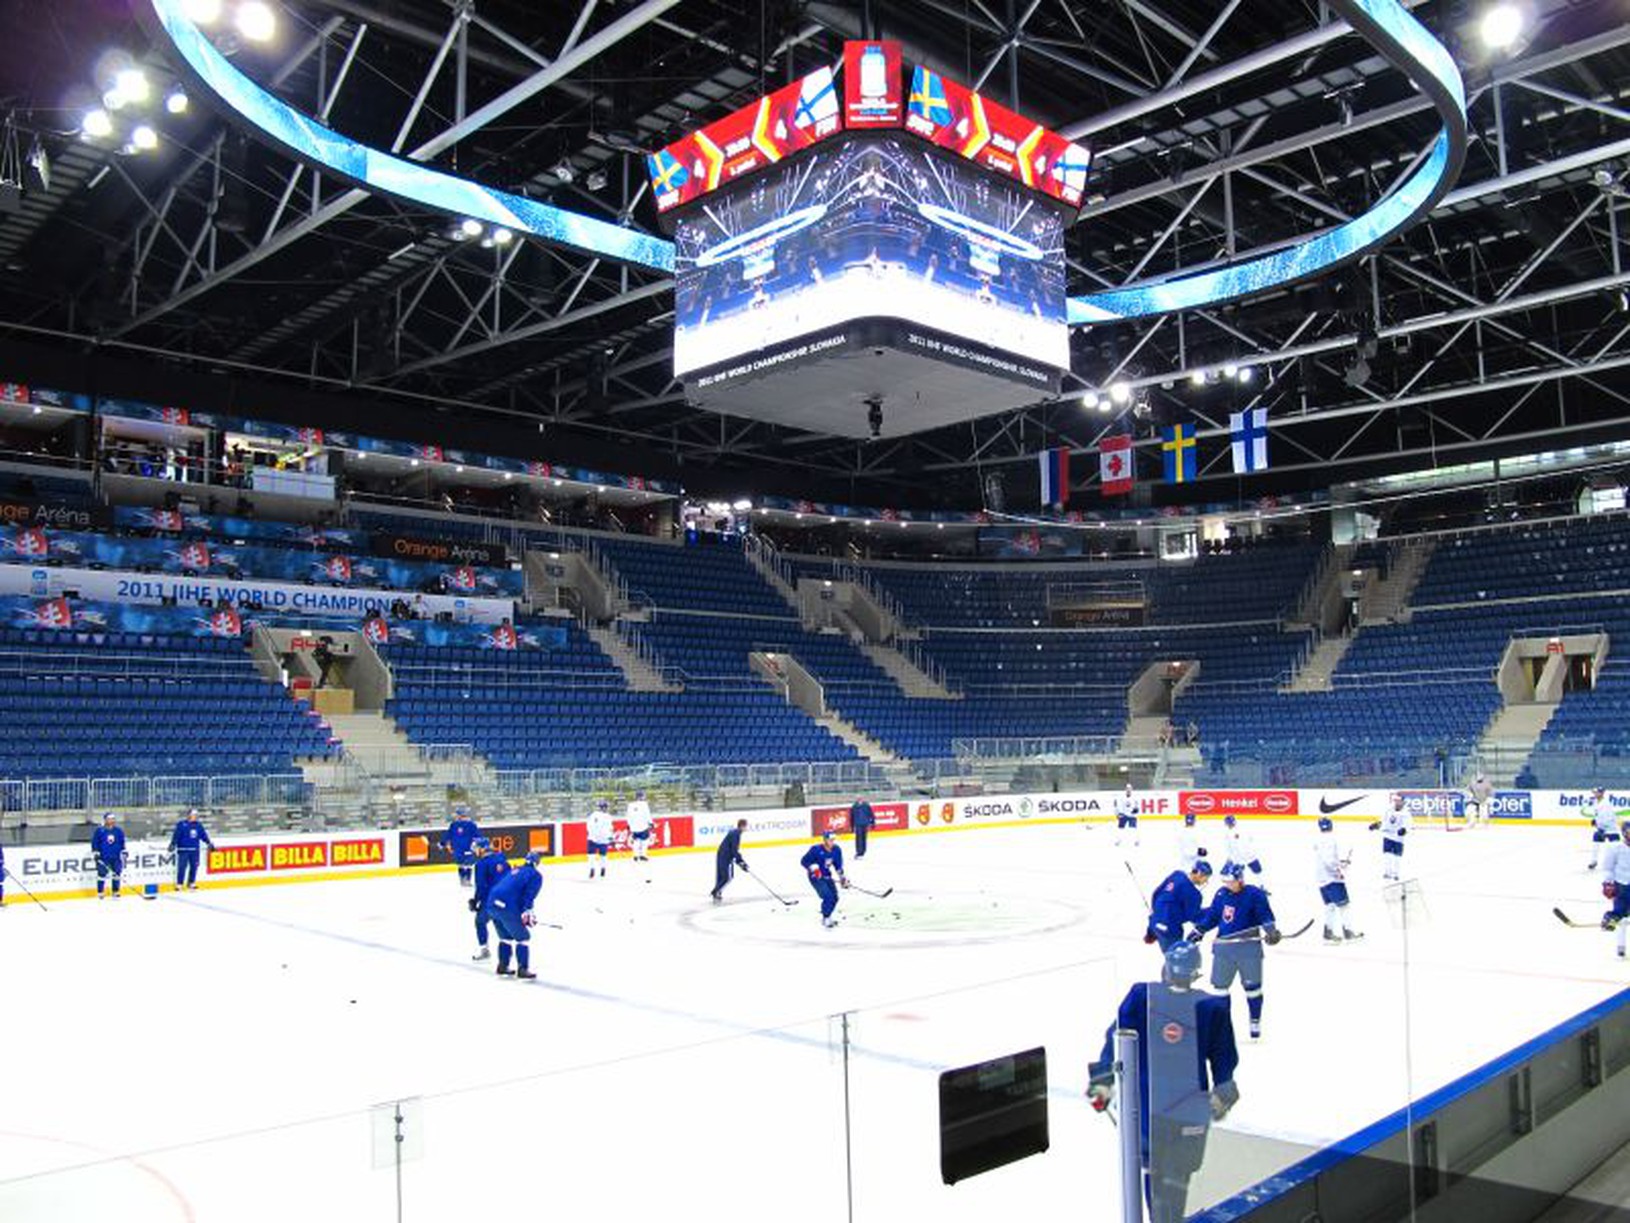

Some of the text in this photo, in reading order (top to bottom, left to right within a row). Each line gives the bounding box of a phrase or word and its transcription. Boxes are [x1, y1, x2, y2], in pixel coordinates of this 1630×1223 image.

[394, 539, 448, 559] Orange
[117, 580, 163, 599] 2011
[217, 586, 287, 607] WORLD
[1141, 799, 1170, 814] HF
[1221, 798, 1258, 809] Henkel
[1490, 796, 1529, 815] pter
[22, 853, 176, 875] EUROHEM
[209, 843, 382, 870] BILLA BILLA BILLA
